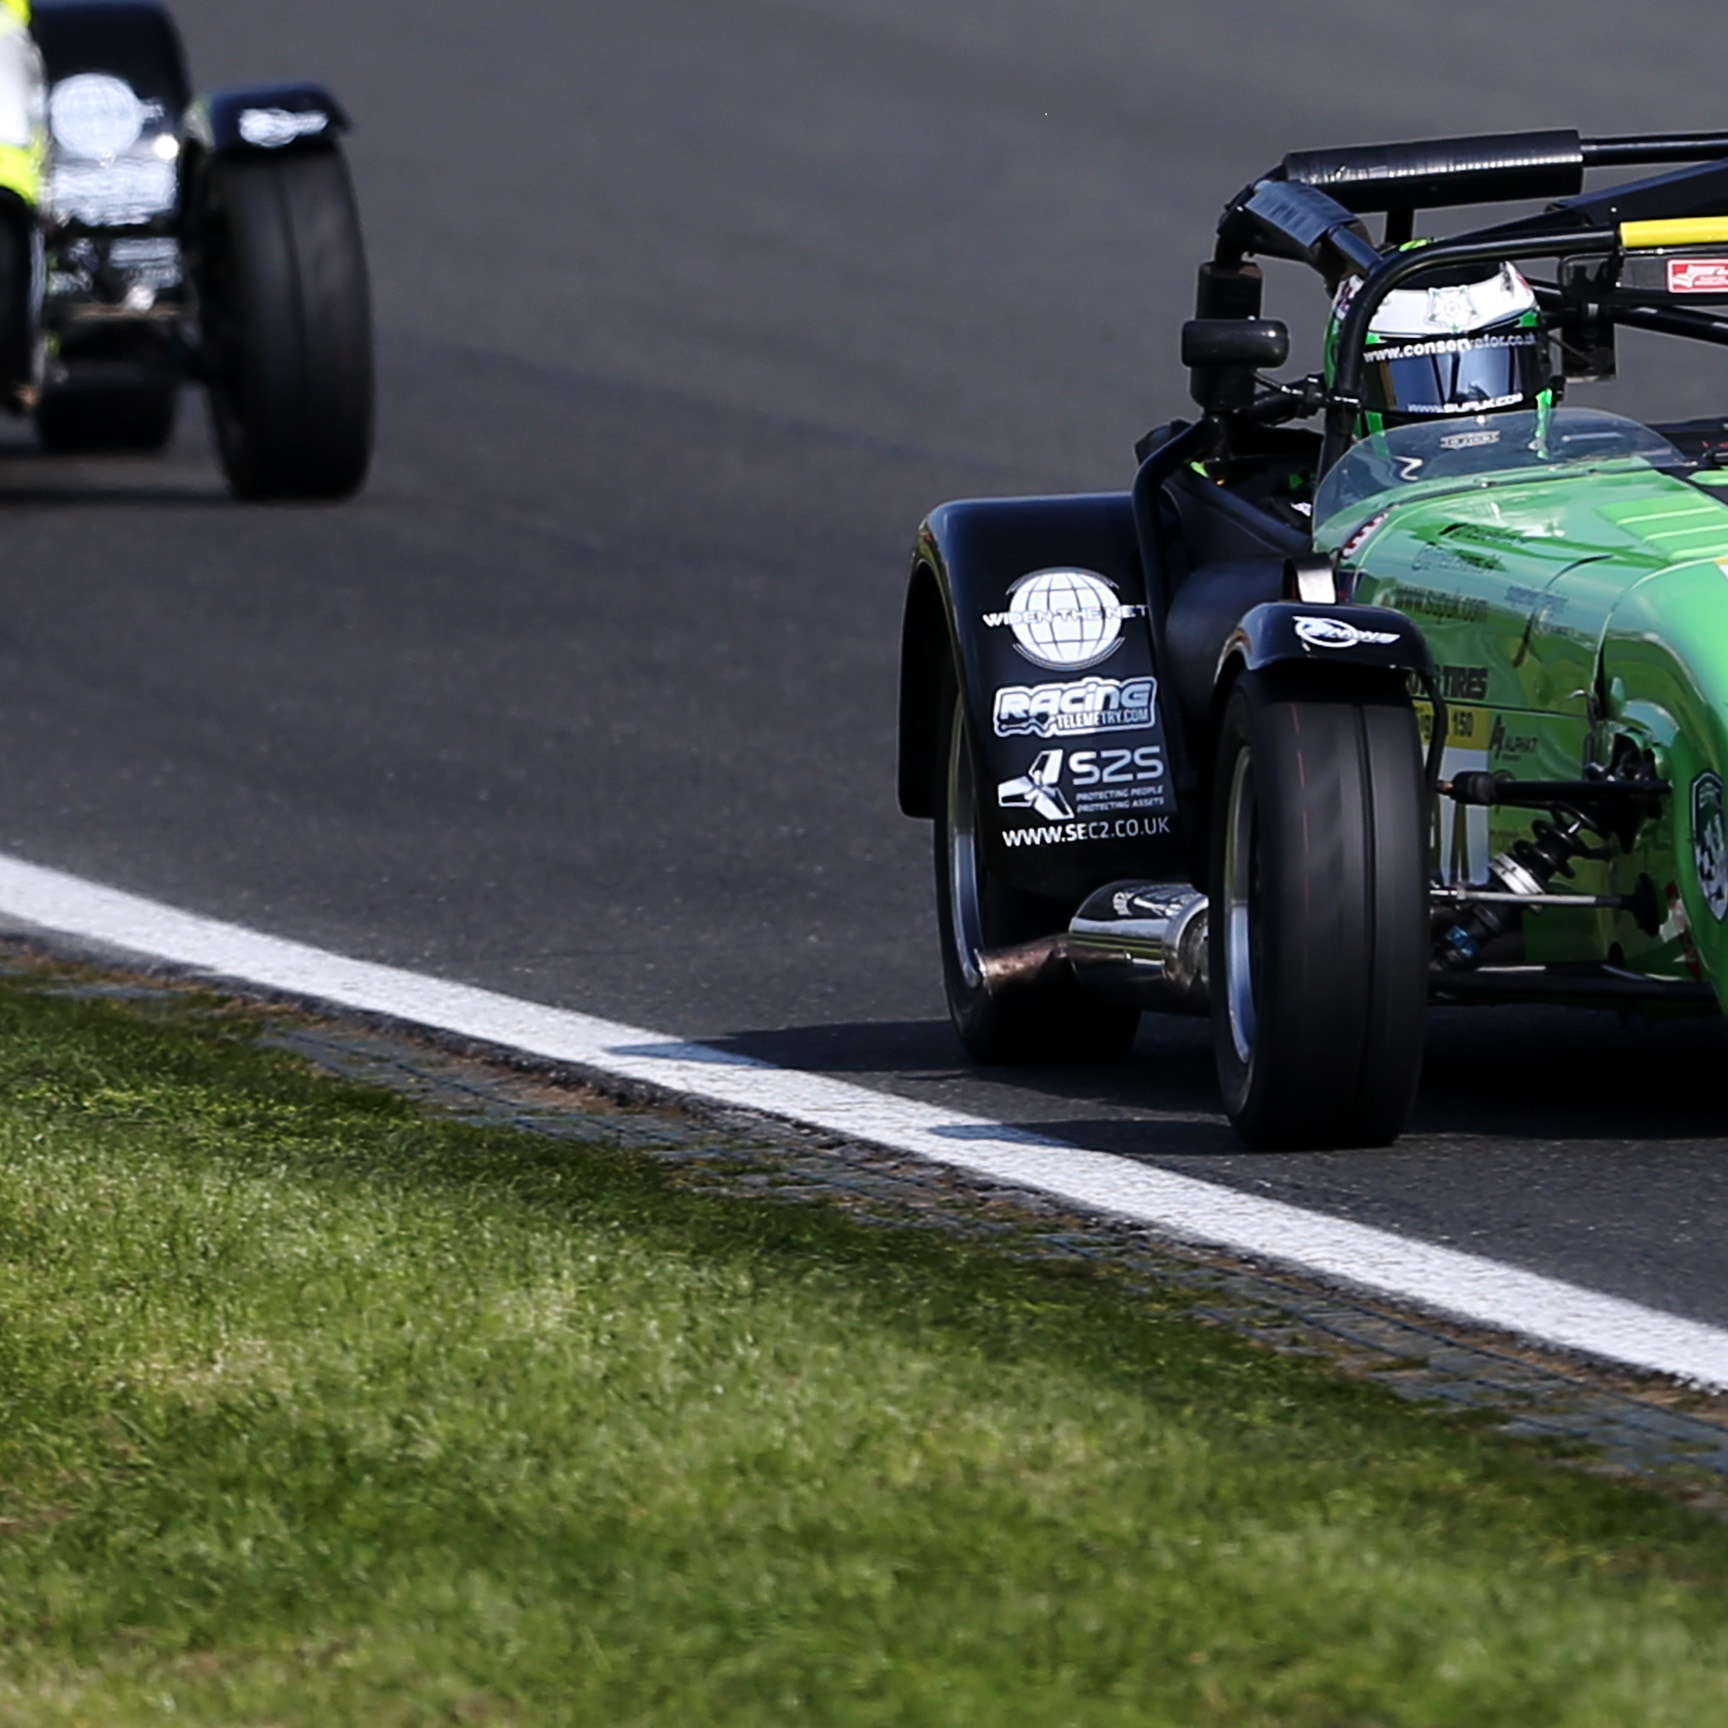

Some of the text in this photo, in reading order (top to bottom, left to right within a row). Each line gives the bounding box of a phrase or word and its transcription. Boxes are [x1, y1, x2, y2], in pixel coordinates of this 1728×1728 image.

[1057, 607, 1101, 622] THE
[1107, 603, 1146, 619] NET
[1054, 707, 1150, 730] TELEMETRY.COM
[1068, 745, 1165, 786] S2S
[1075, 785, 1163, 802] PROTECTING PEOPLE
[1076, 797, 1165, 813] PROTECTING ASSETS
[1002, 817, 1171, 848] WWW.SEC2.CO.UK
